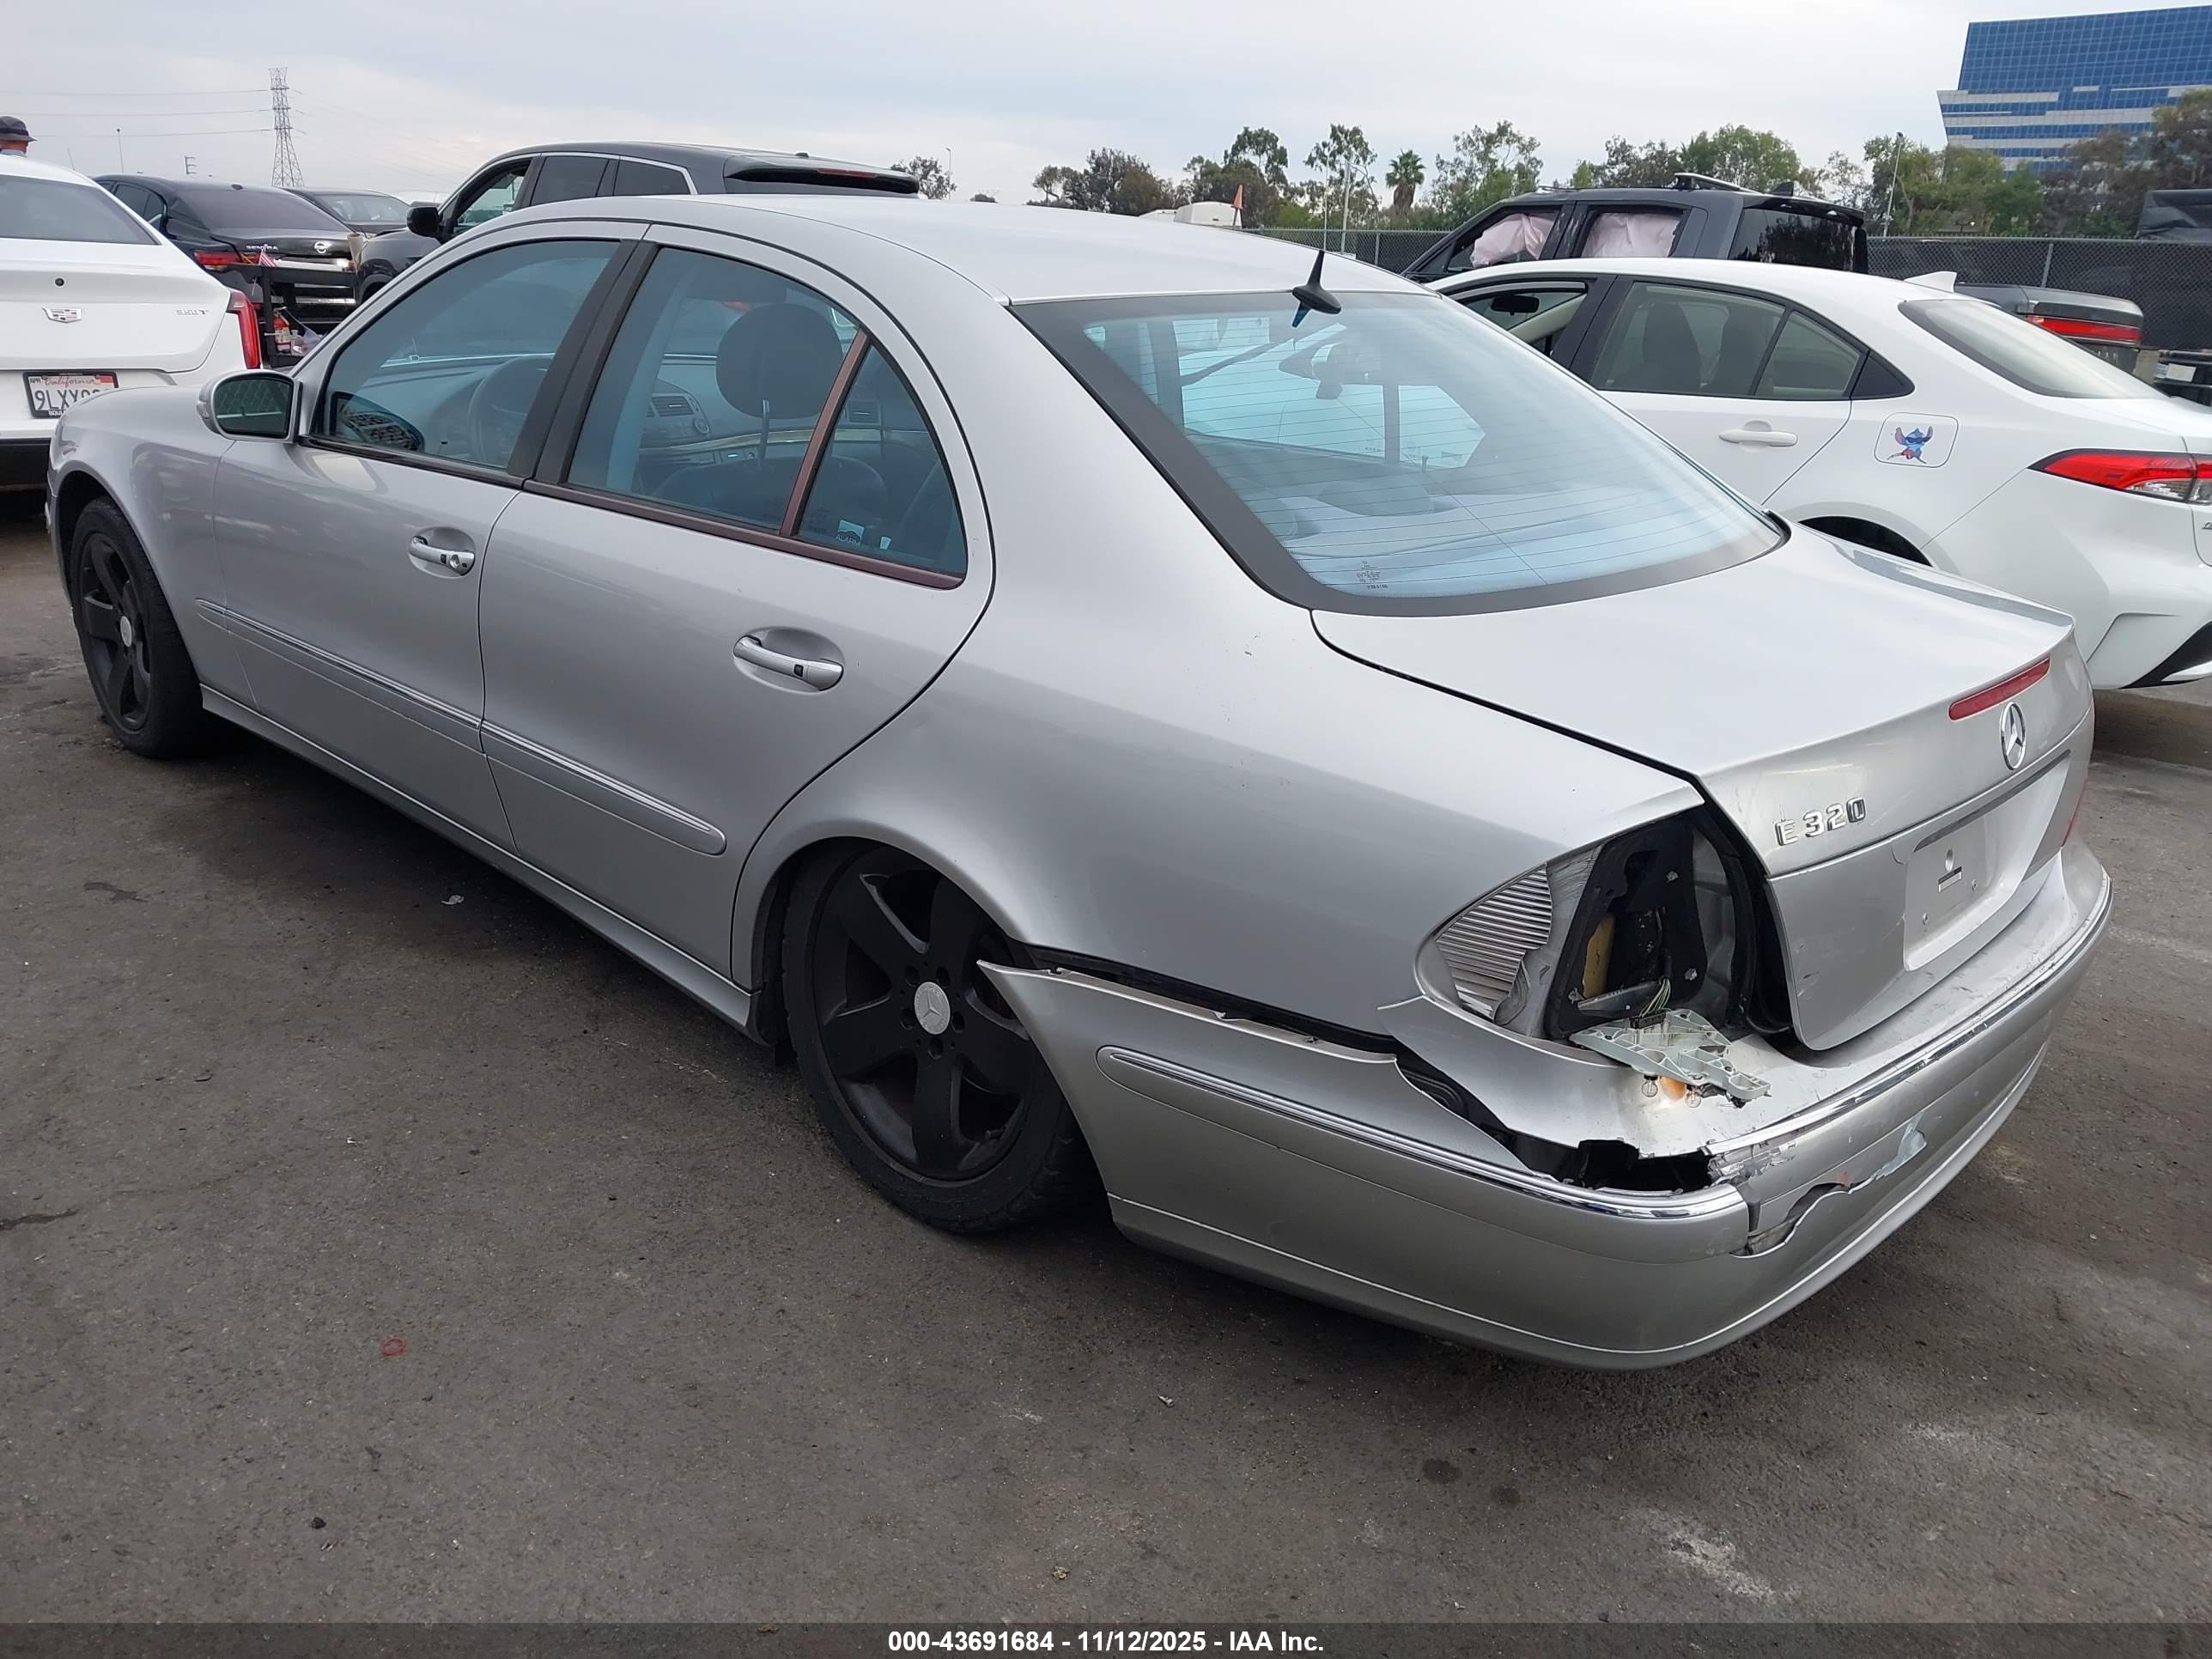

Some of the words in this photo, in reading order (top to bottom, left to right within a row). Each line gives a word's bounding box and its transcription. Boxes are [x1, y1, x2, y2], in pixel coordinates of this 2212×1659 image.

[44, 375, 100, 388] California
[1774, 818, 1799, 846] E
[1802, 797, 1867, 838] 320
